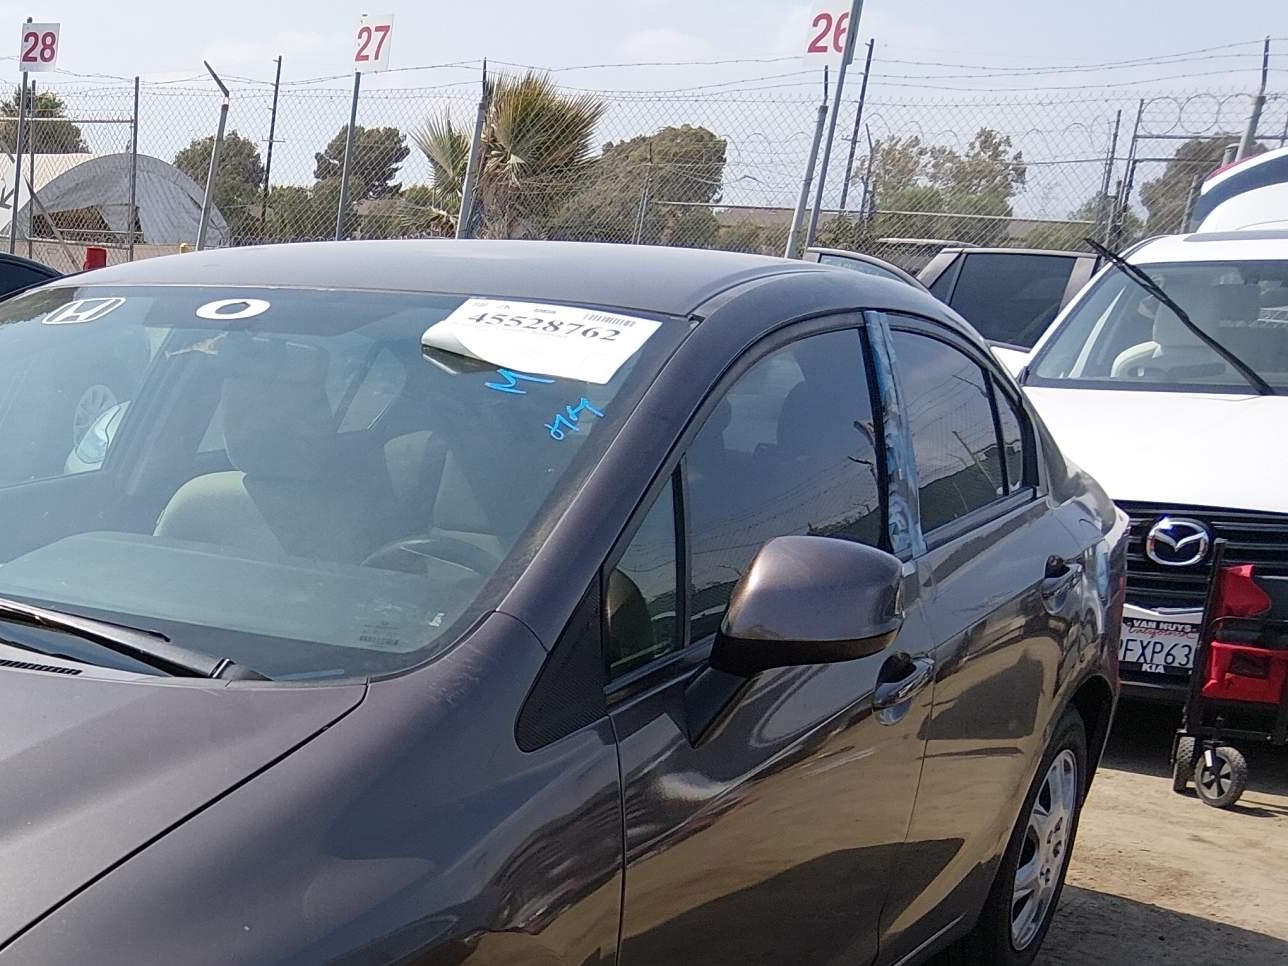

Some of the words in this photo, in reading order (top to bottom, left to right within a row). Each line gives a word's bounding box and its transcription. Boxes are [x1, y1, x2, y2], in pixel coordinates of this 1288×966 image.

[22, 31, 56, 62] 28
[355, 25, 390, 61] 27
[468, 312, 621, 341] 45528762
[1133, 619, 1157, 629] VAN
[1159, 622, 1193, 632] NUYS
[1120, 638, 1193, 667] FXP63
[1142, 663, 1165, 673] KIA
